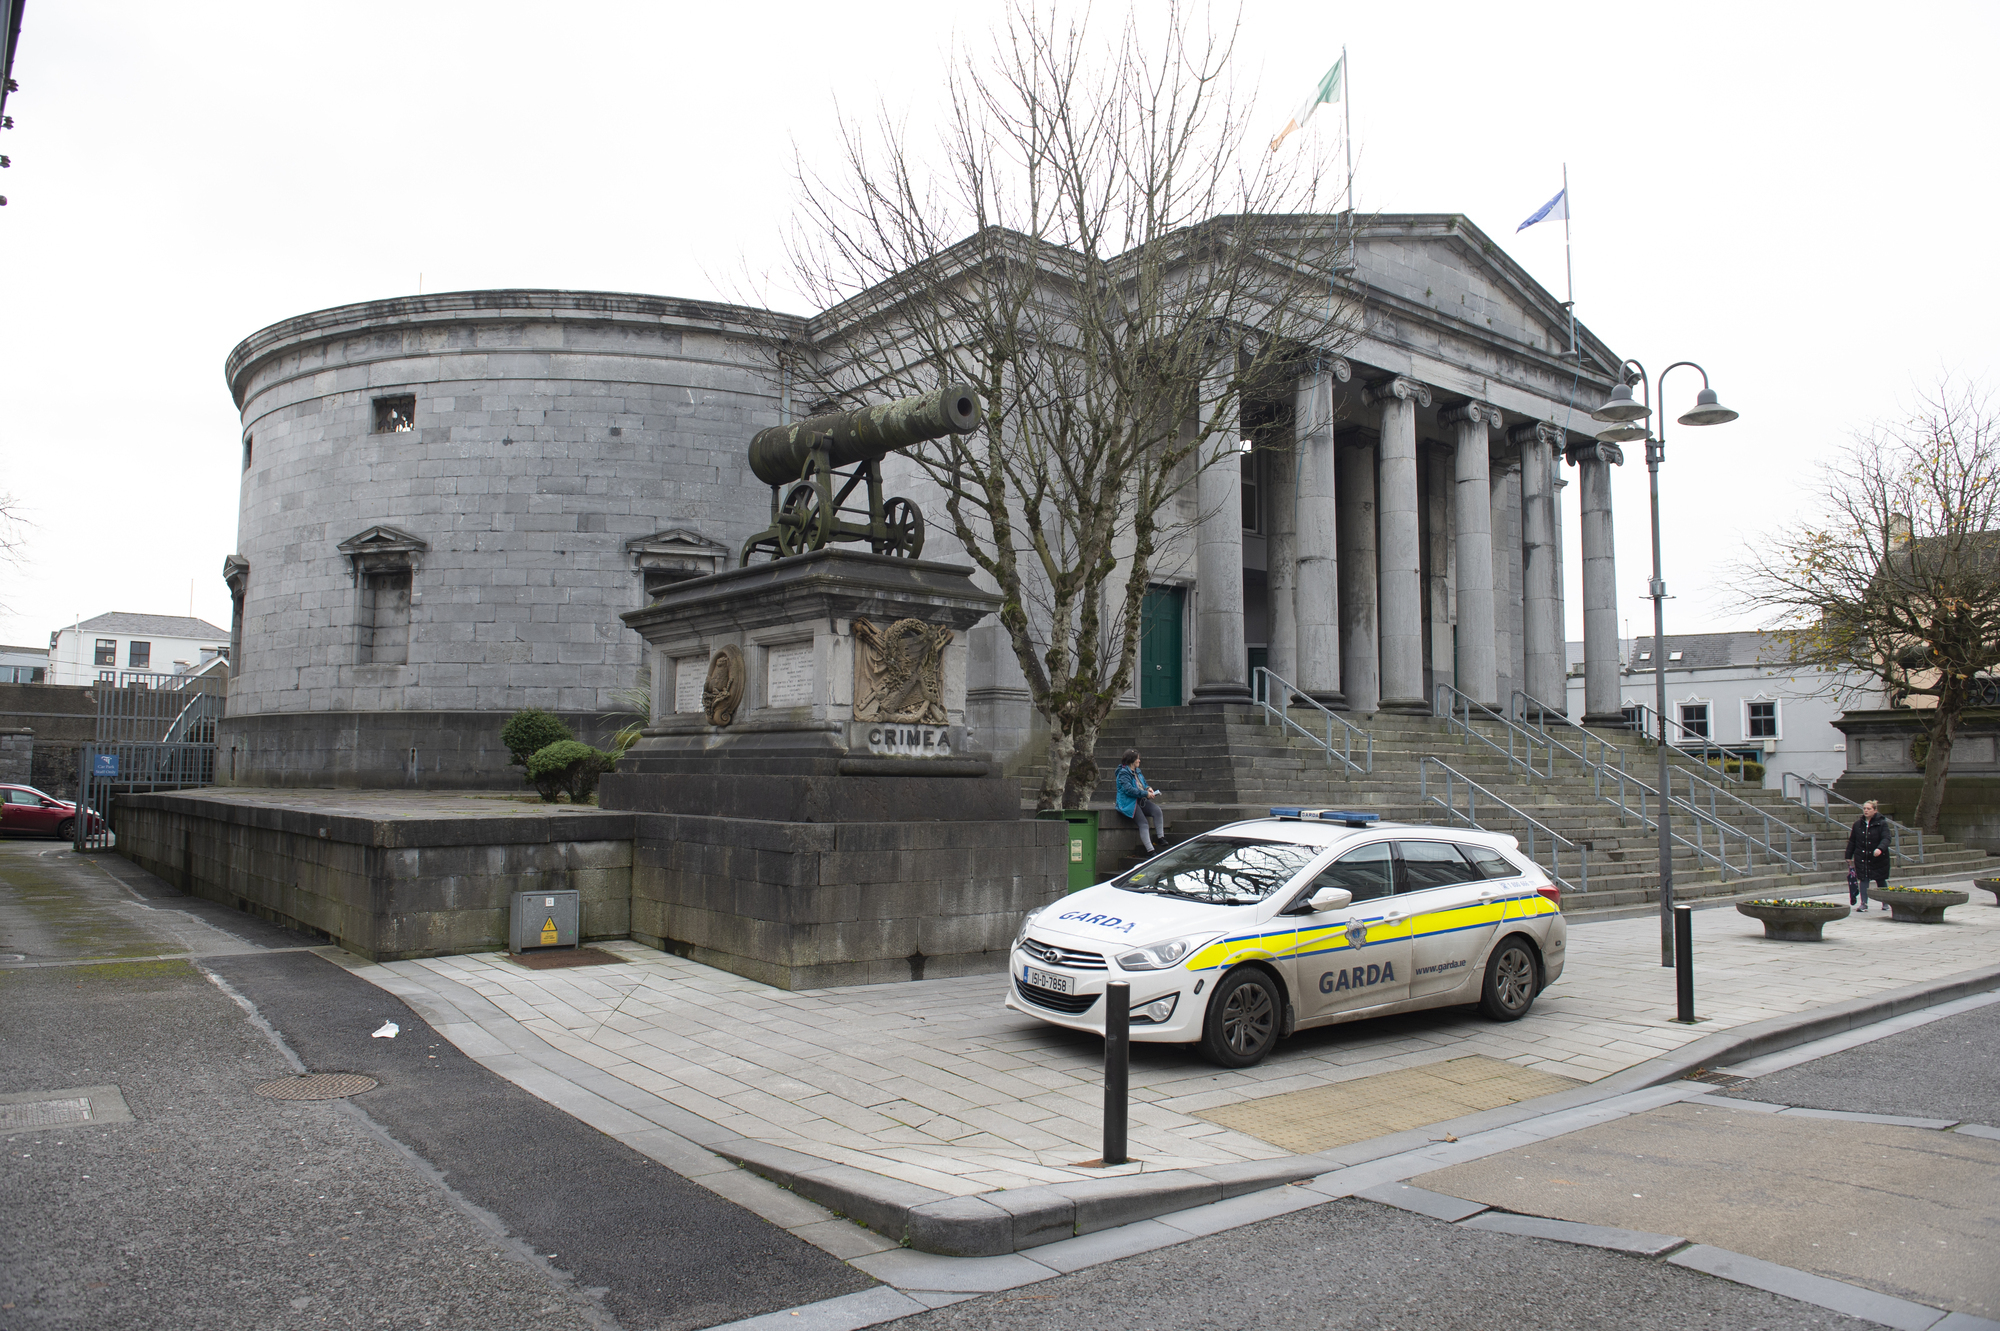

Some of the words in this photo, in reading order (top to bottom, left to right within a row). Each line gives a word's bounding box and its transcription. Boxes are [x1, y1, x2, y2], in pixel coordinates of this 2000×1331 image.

[869, 728, 951, 747] CRIMEA
[1058, 911, 1136, 933] GARDA
[1415, 959, 1467, 975] www.garda.ie
[1031, 972, 1067, 992] 151-D-7858
[1319, 961, 1395, 994] GARDA
